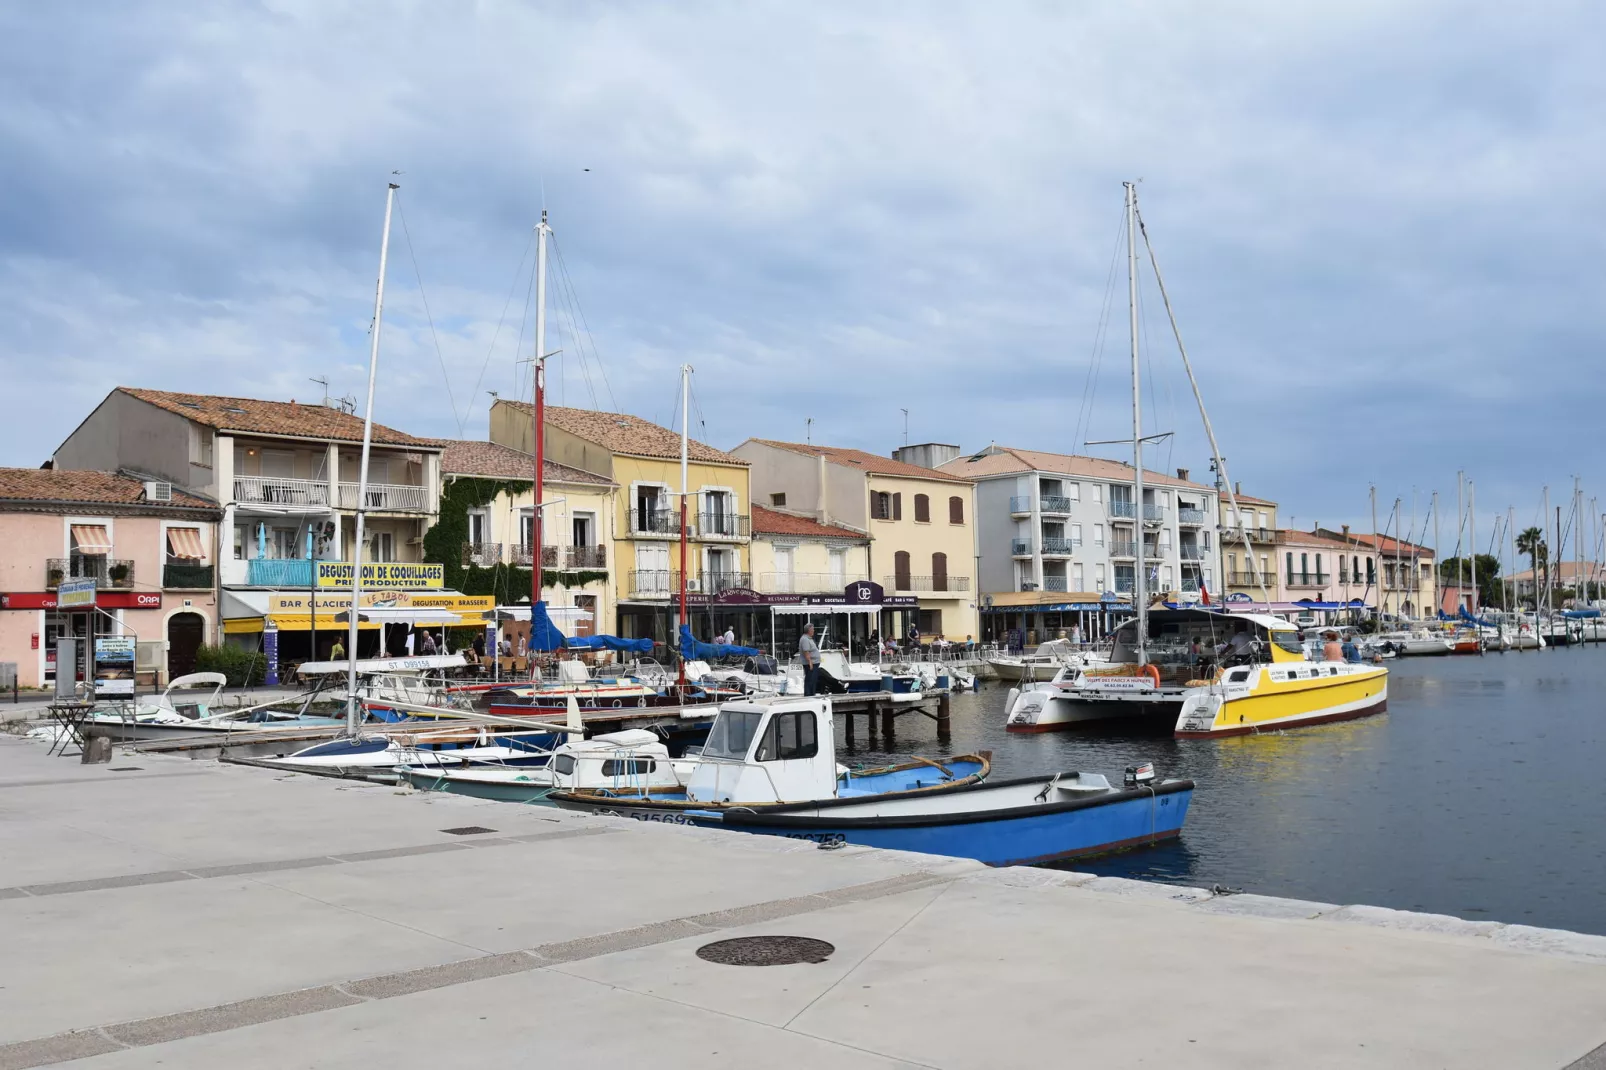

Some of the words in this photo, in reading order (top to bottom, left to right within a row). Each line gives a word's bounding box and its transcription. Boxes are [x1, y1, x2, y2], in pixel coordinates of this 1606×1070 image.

[320, 565, 374, 578] DEGUSTAION
[377, 566, 387, 579] DE
[367, 594, 377, 604] LE
[380, 592, 409, 602] TABOU
[280, 600, 302, 608] BAR
[308, 600, 353, 608] GLACIER
[388, 661, 398, 669] ST
